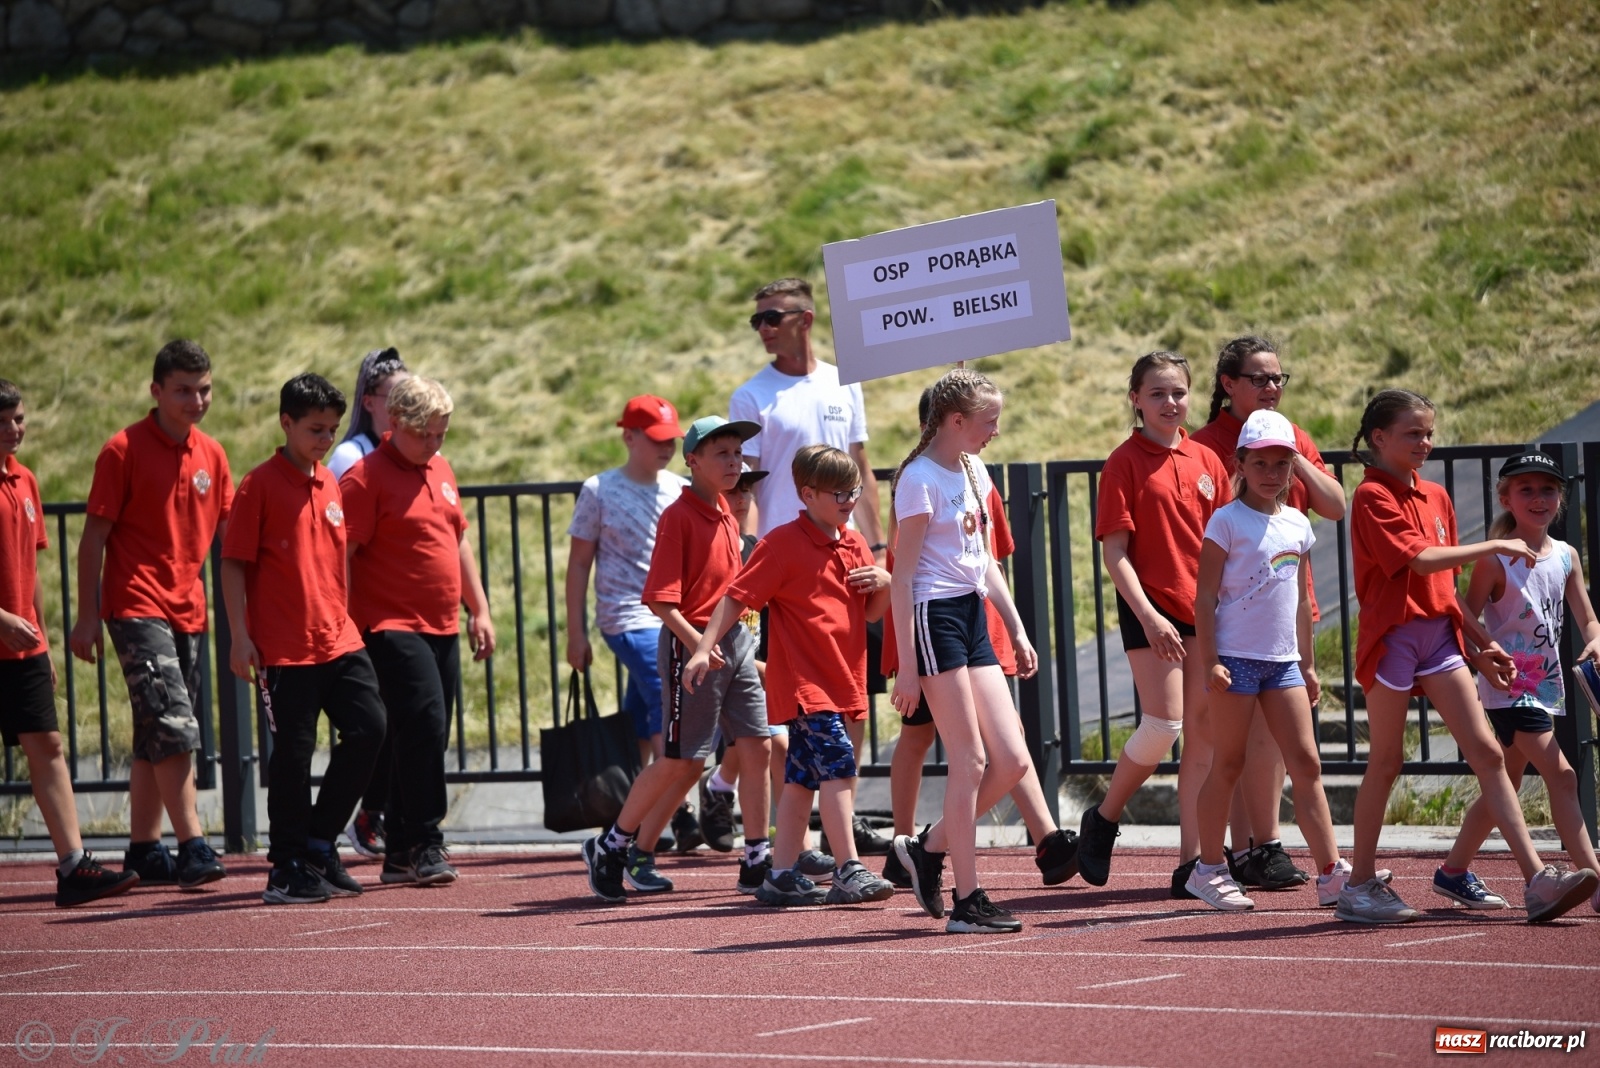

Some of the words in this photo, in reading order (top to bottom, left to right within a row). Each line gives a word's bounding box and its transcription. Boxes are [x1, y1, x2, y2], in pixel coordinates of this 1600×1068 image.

[873, 261, 910, 283] OSP
[928, 242, 1017, 272] PORĄBKA
[882, 307, 934, 330] POW.
[953, 290, 1018, 317] BIELSKI
[828, 405, 842, 414] OSP
